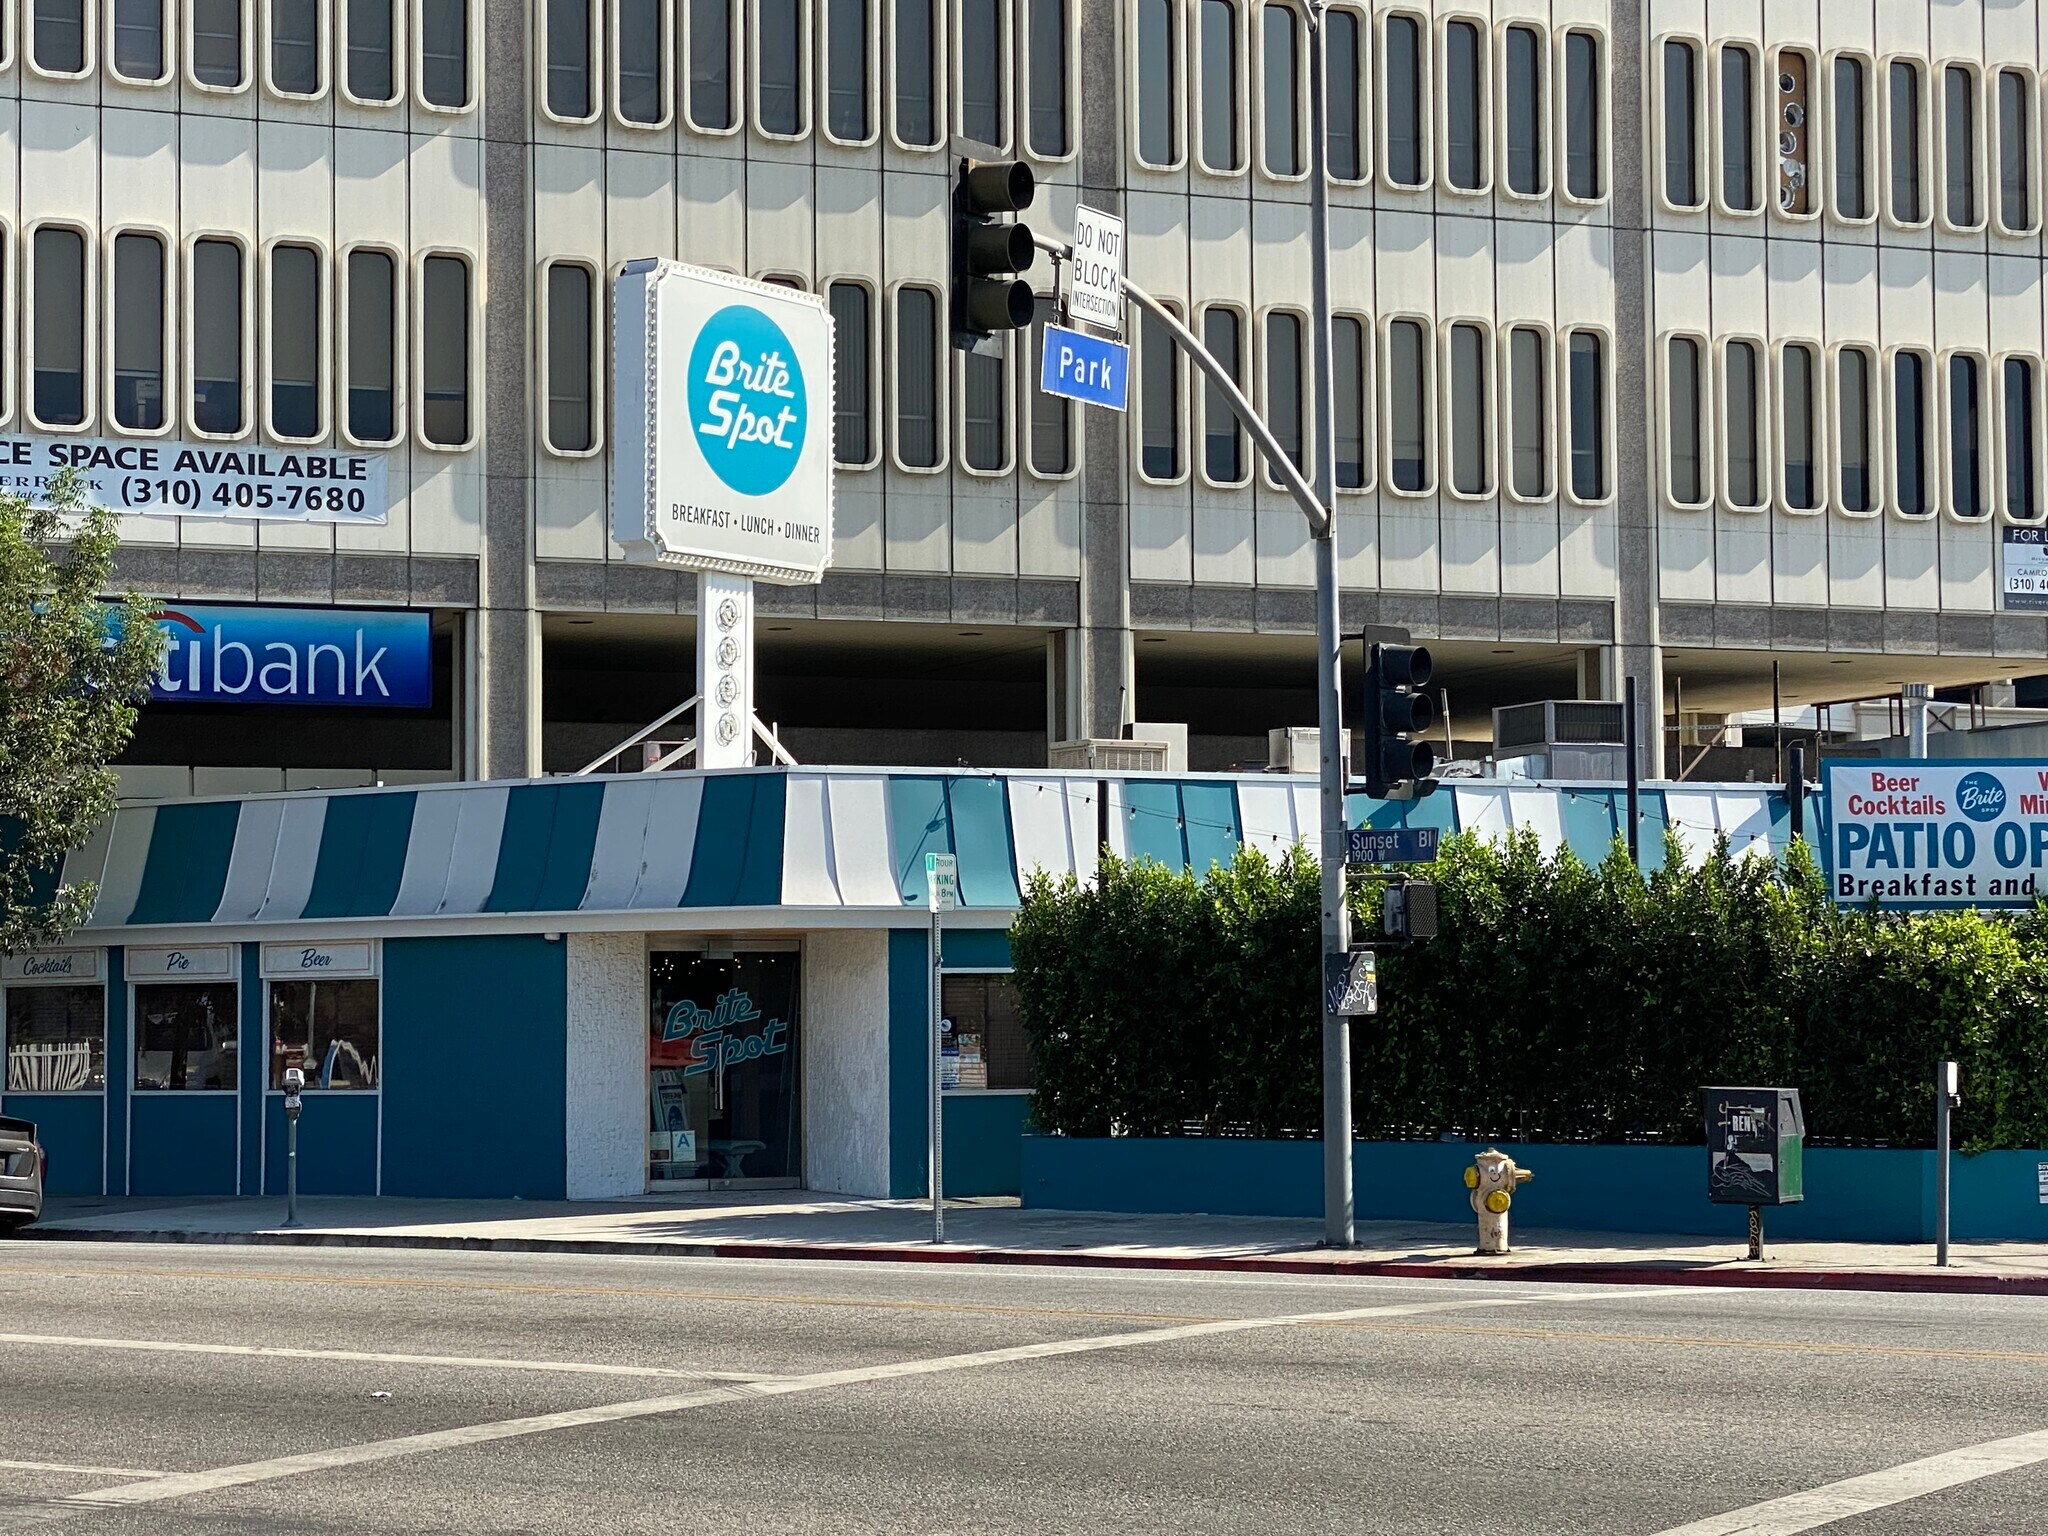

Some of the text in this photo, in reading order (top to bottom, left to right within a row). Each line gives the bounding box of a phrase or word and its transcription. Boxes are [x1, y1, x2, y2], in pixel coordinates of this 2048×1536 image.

[1076, 222, 1120, 257] DO NOT
[1074, 257, 1117, 293] BLOCK
[1072, 290, 1117, 317] INTERSECTION
[704, 340, 796, 399] Brite
[1059, 345, 1112, 390] Park
[698, 389, 798, 450] Spot
[48, 443, 159, 471] SPACE
[173, 450, 367, 481] AVAILABLE
[121, 476, 365, 513] (310) 405-7680
[672, 503, 820, 544] BREAKFAST LUNCH DINNER
[2013, 529, 2039, 542] FOR
[2009, 577, 2048, 592] (310) 4
[84, 622, 391, 697] tibank
[1871, 772, 1920, 792] Beer
[1848, 794, 1946, 816] Cocktails
[1961, 786, 2005, 810] Brite
[2019, 794, 2048, 815] Mi
[1352, 831, 1432, 850] Sunset Bl
[1837, 821, 1976, 869] PATIO
[1352, 850, 1386, 861] 1900 W
[1838, 872, 2036, 896] Breakfast and
[23, 955, 73, 976] Cocktails
[166, 951, 190, 971] Pie
[300, 948, 333, 969] Beer
[662, 987, 762, 1042] Brite
[683, 1017, 788, 1077] Spot
[677, 1133, 690, 1148] A
